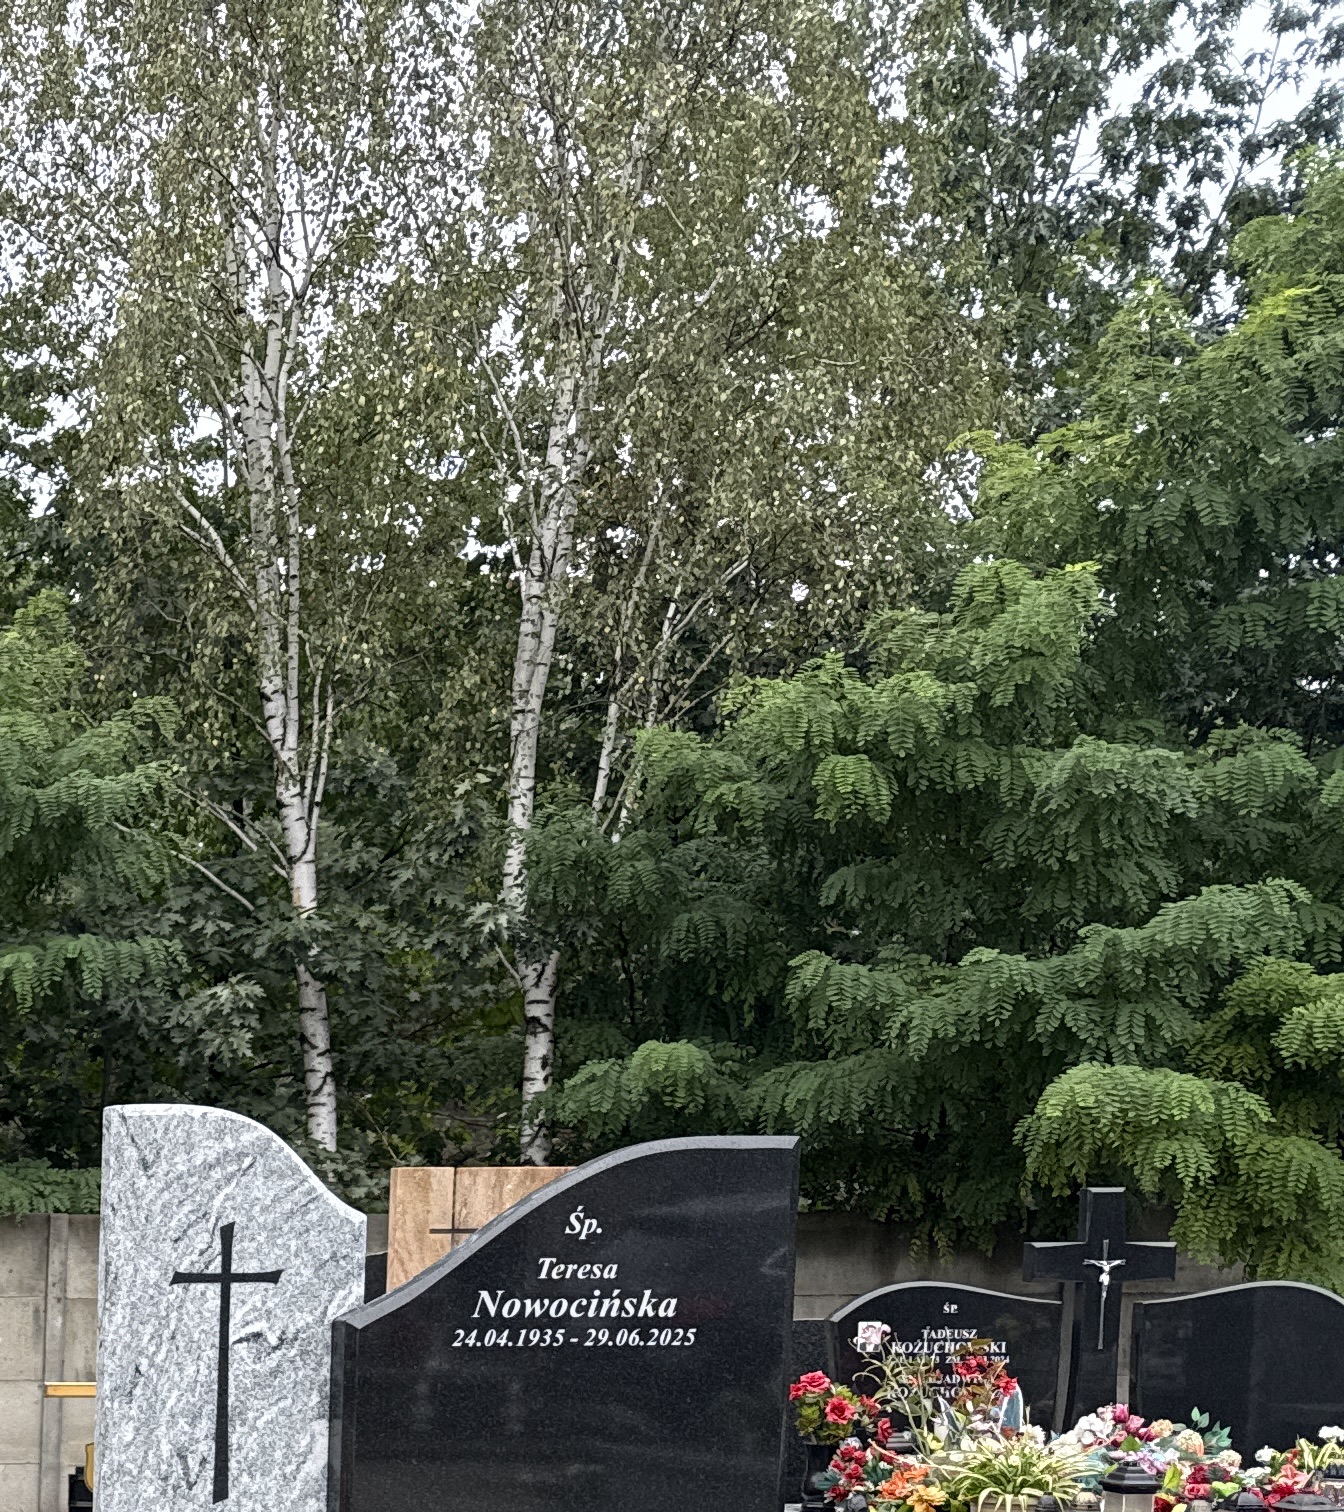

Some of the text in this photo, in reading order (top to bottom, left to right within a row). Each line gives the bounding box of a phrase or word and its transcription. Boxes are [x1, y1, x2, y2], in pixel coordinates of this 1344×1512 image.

[564, 1205, 603, 1240] Śp.
[537, 1257, 619, 1280] Teresa
[470, 1288, 678, 1319] Nowocińska
[451, 1327, 566, 1348] 24.04.1935
[582, 1327, 698, 1348] 29.06.2025
[921, 1328, 979, 1340] TADEUSZ
